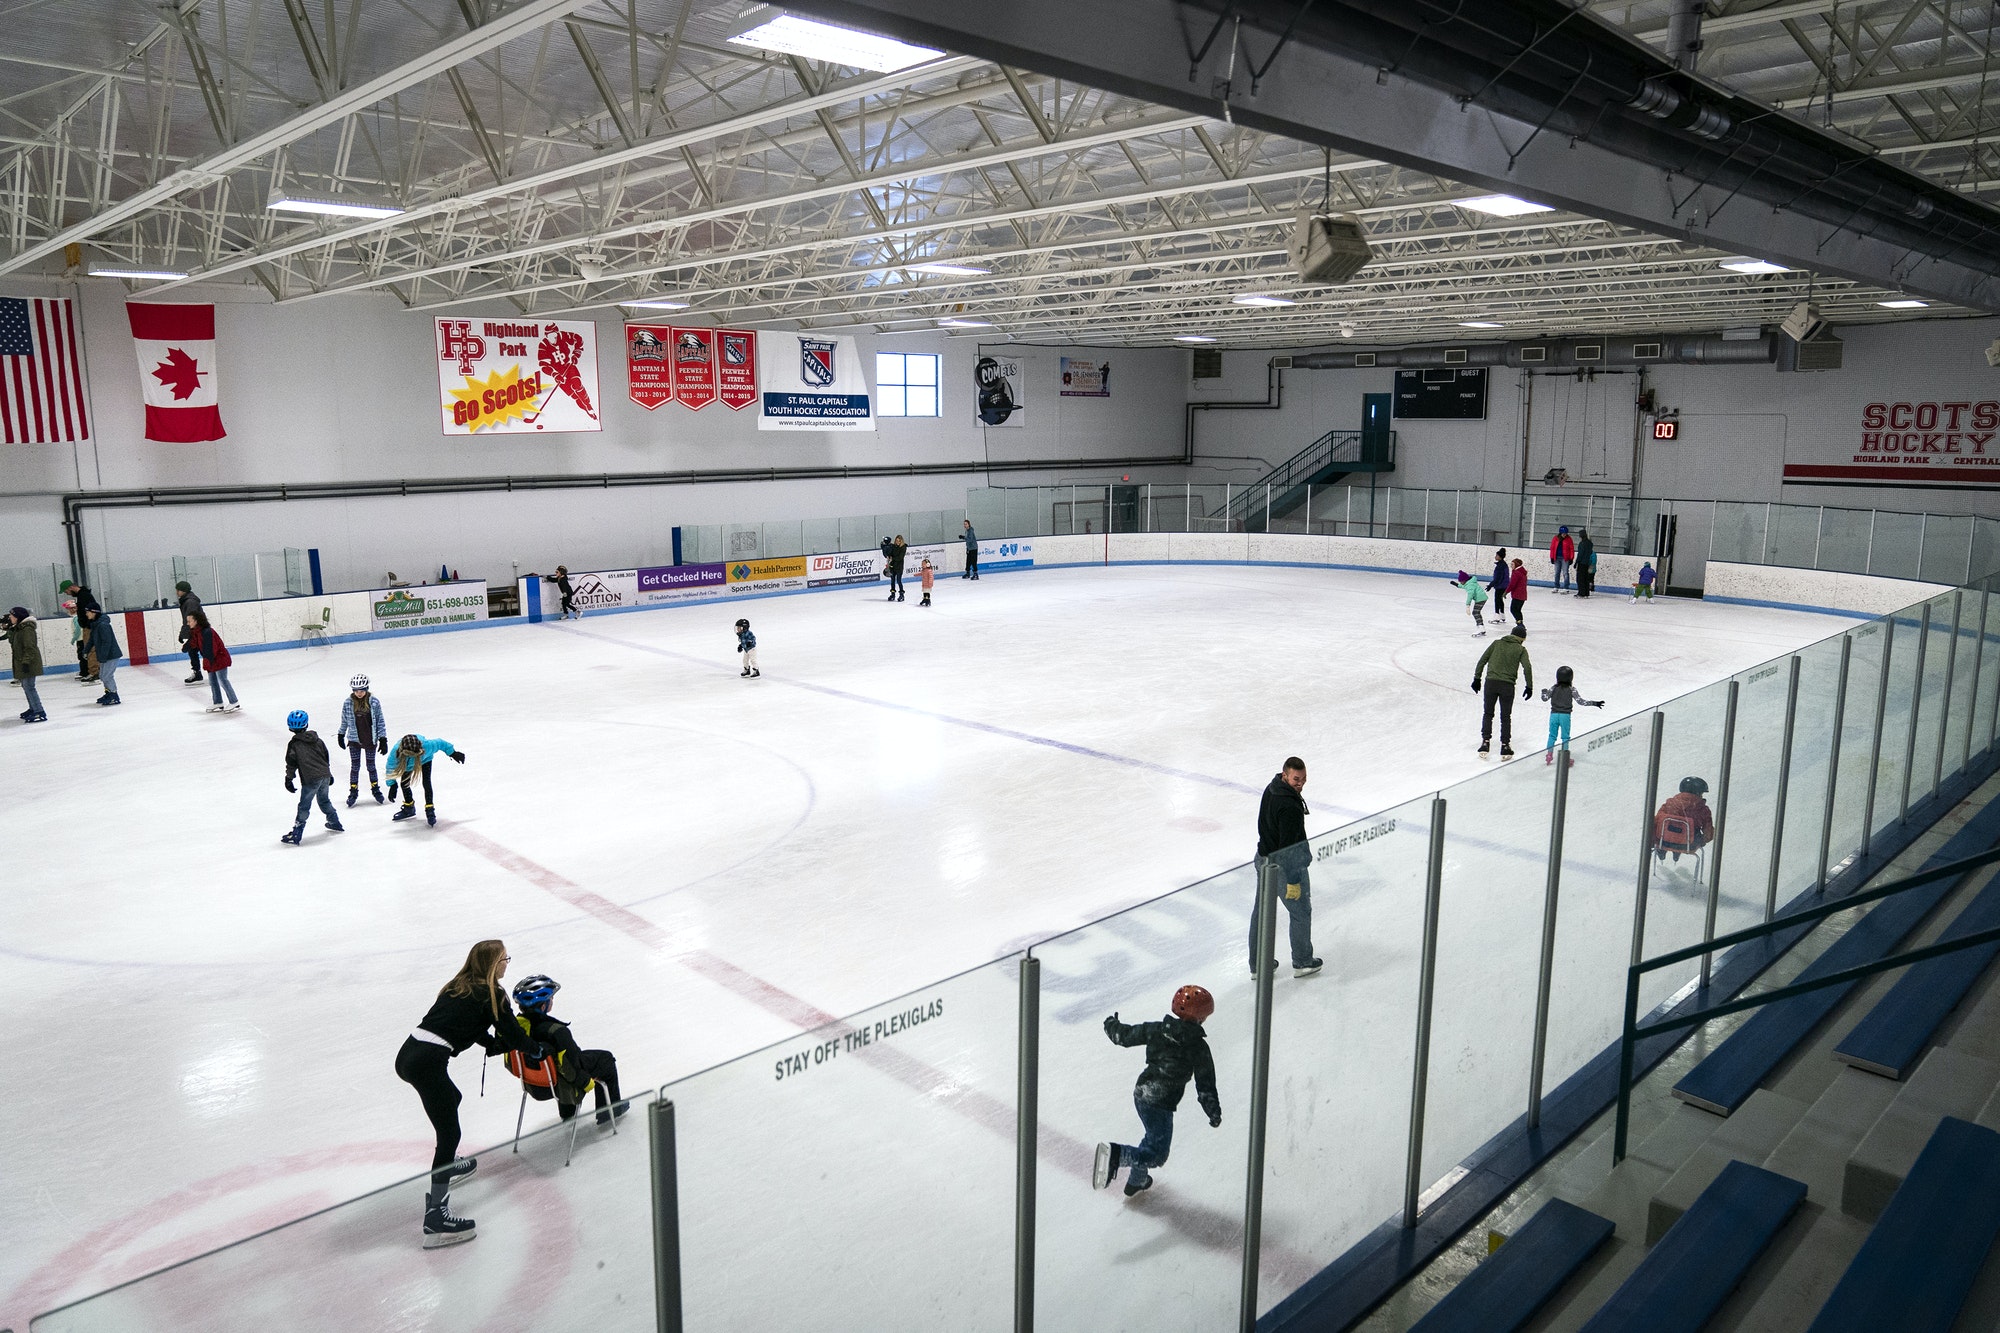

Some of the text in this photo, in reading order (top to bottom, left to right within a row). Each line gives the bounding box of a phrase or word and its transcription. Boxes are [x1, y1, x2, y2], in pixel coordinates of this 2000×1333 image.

[484, 322, 539, 338] Highland
[499, 342, 527, 356] Park
[804, 342, 819, 350] SAINT
[803, 350, 831, 383] CAPITALS
[981, 363, 1017, 383] COMETS
[788, 396, 797, 404] ST.
[817, 397, 848, 405] CAPITALS
[794, 407, 821, 415] HOCKEY
[1862, 400, 2000, 431] SCOTS
[1656, 424, 1674, 438] 00
[1860, 432, 1996, 454] HOCKEY
[753, 564, 801, 574] HealthPartners
[815, 559, 832, 569] UR
[835, 559, 874, 569] URGENCY
[846, 567, 872, 575] ROOM
[643, 570, 722, 585] Get Checked Here
[731, 585, 752, 593] Sports
[753, 582, 780, 590] Medicine
[427, 595, 484, 610] 651-698-0353
[570, 593, 622, 605] ADITION
[377, 604, 402, 616] Green
[402, 601, 422, 612] Mill
[384, 619, 410, 629] CORNER
[420, 617, 442, 625] GRAND
[449, 613, 476, 622] HAMLINE
[1317, 819, 1396, 862] STAY OFF THE PLEXIGLAS
[775, 998, 943, 1080] STAY OFF THE PLEXIGLAS
